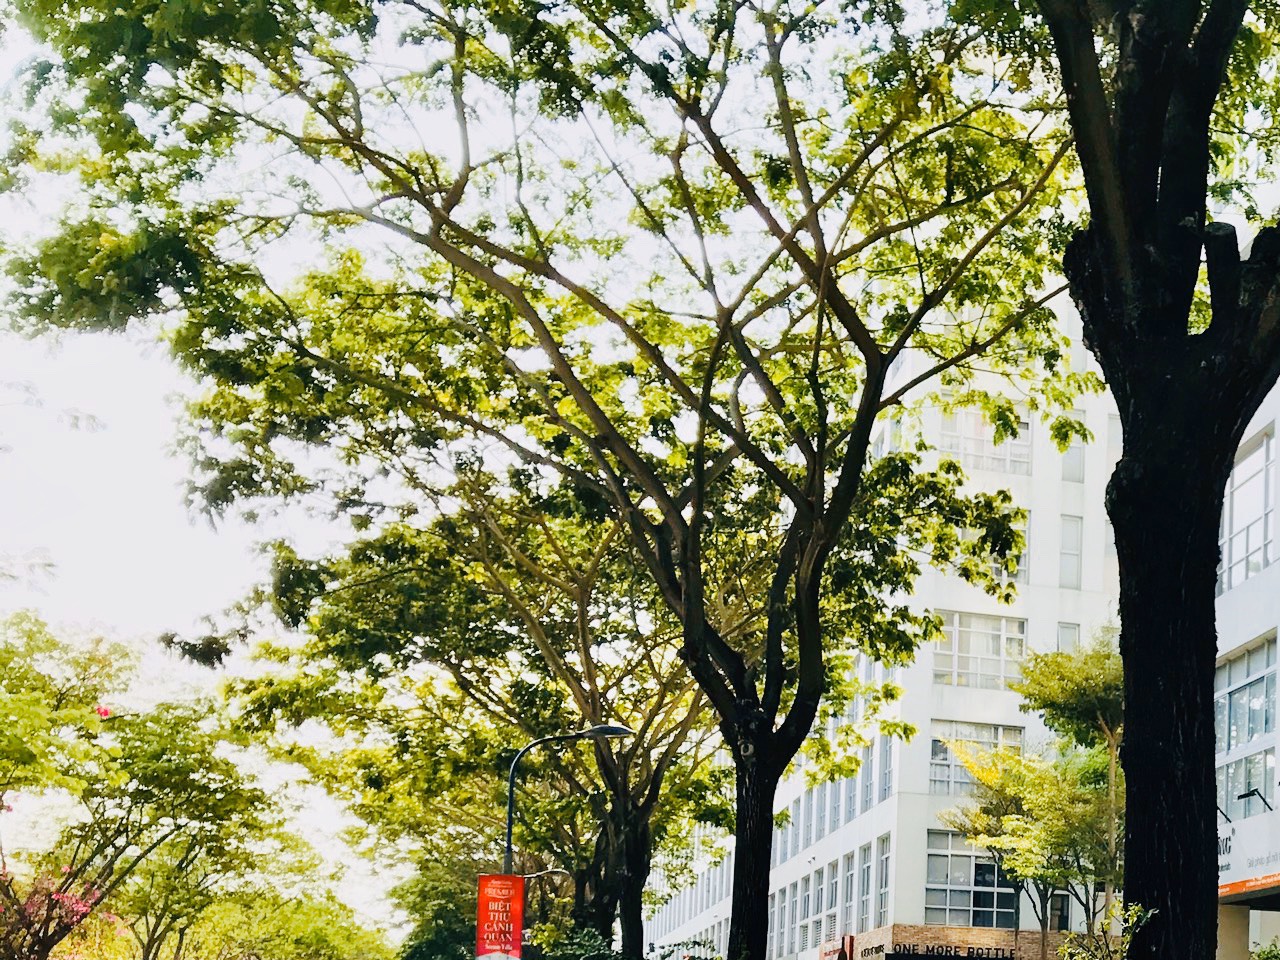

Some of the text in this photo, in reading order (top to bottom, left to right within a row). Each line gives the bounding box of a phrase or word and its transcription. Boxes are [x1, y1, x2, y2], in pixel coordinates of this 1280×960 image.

[893, 944, 919, 954] ONE
[925, 945, 961, 956] MORE
[967, 947, 1016, 960] BOTTLE
